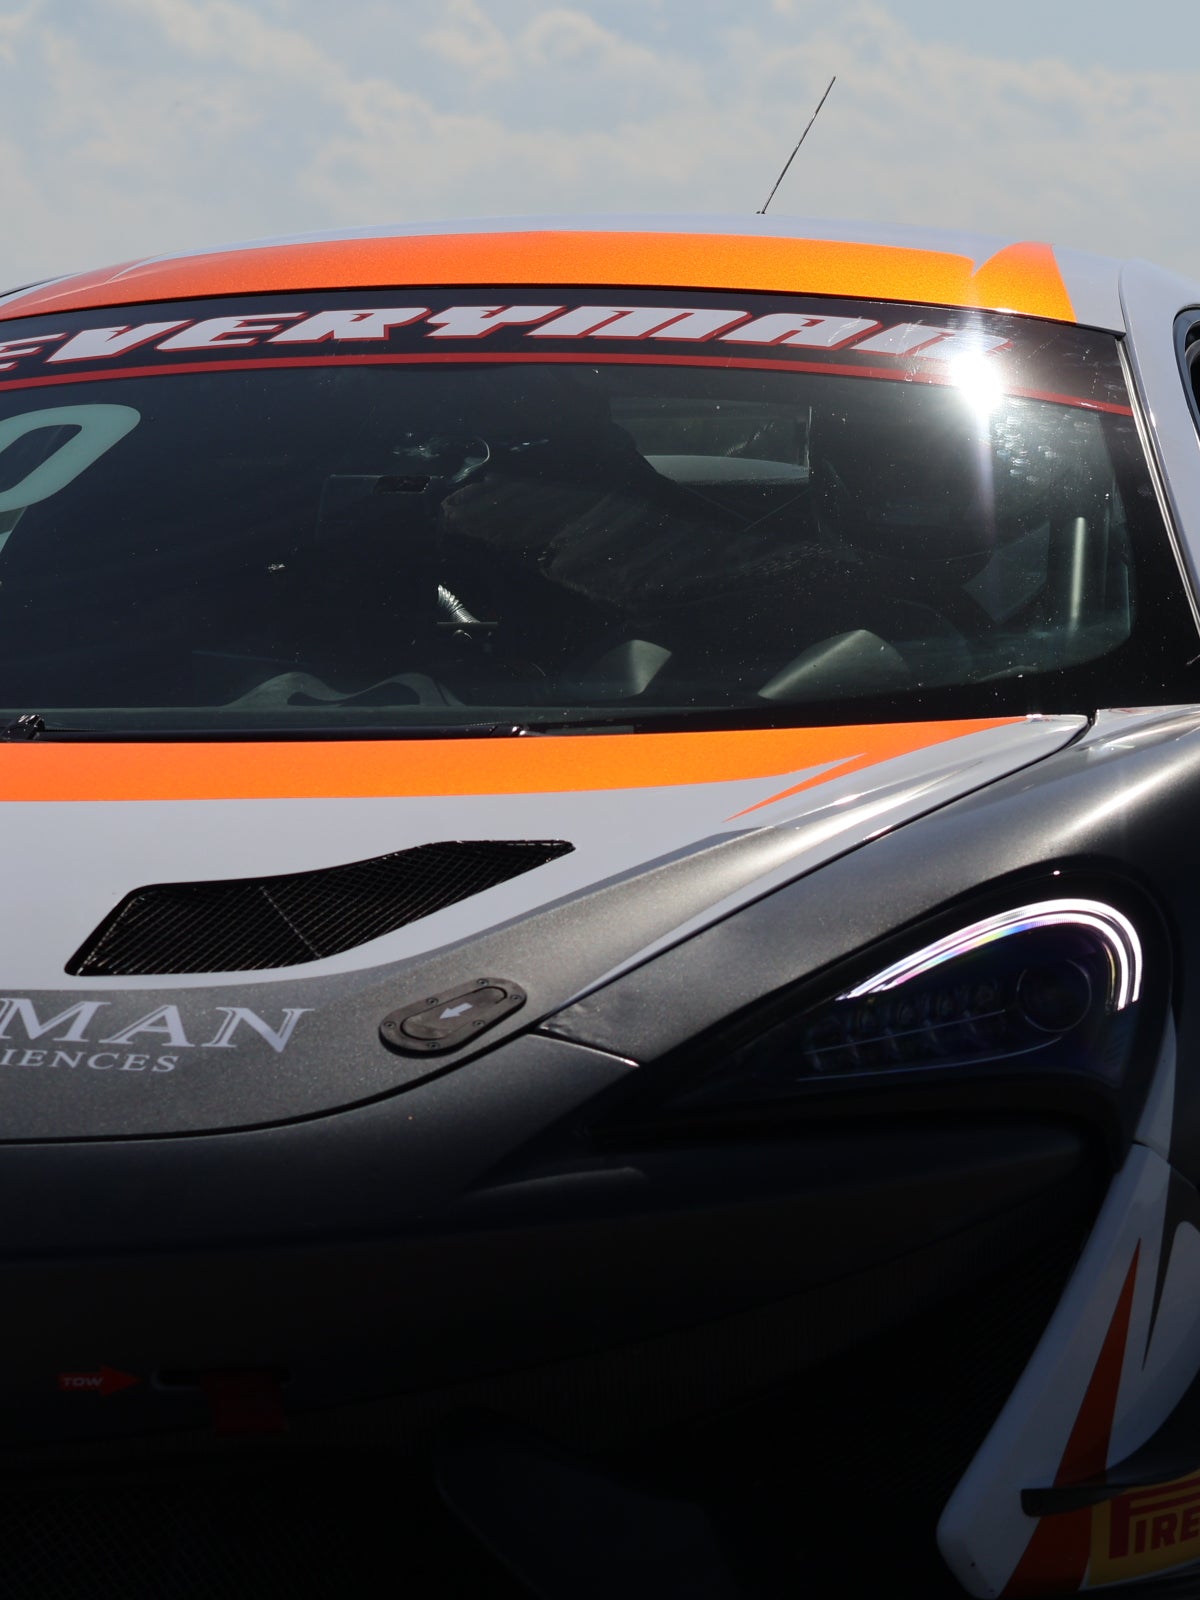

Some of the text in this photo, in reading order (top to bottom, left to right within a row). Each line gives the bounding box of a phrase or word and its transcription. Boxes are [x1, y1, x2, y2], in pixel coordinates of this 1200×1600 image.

[0, 997, 316, 1053] MAN
[0, 1048, 180, 1074] IENCES
[62, 1375, 105, 1388] TOW
